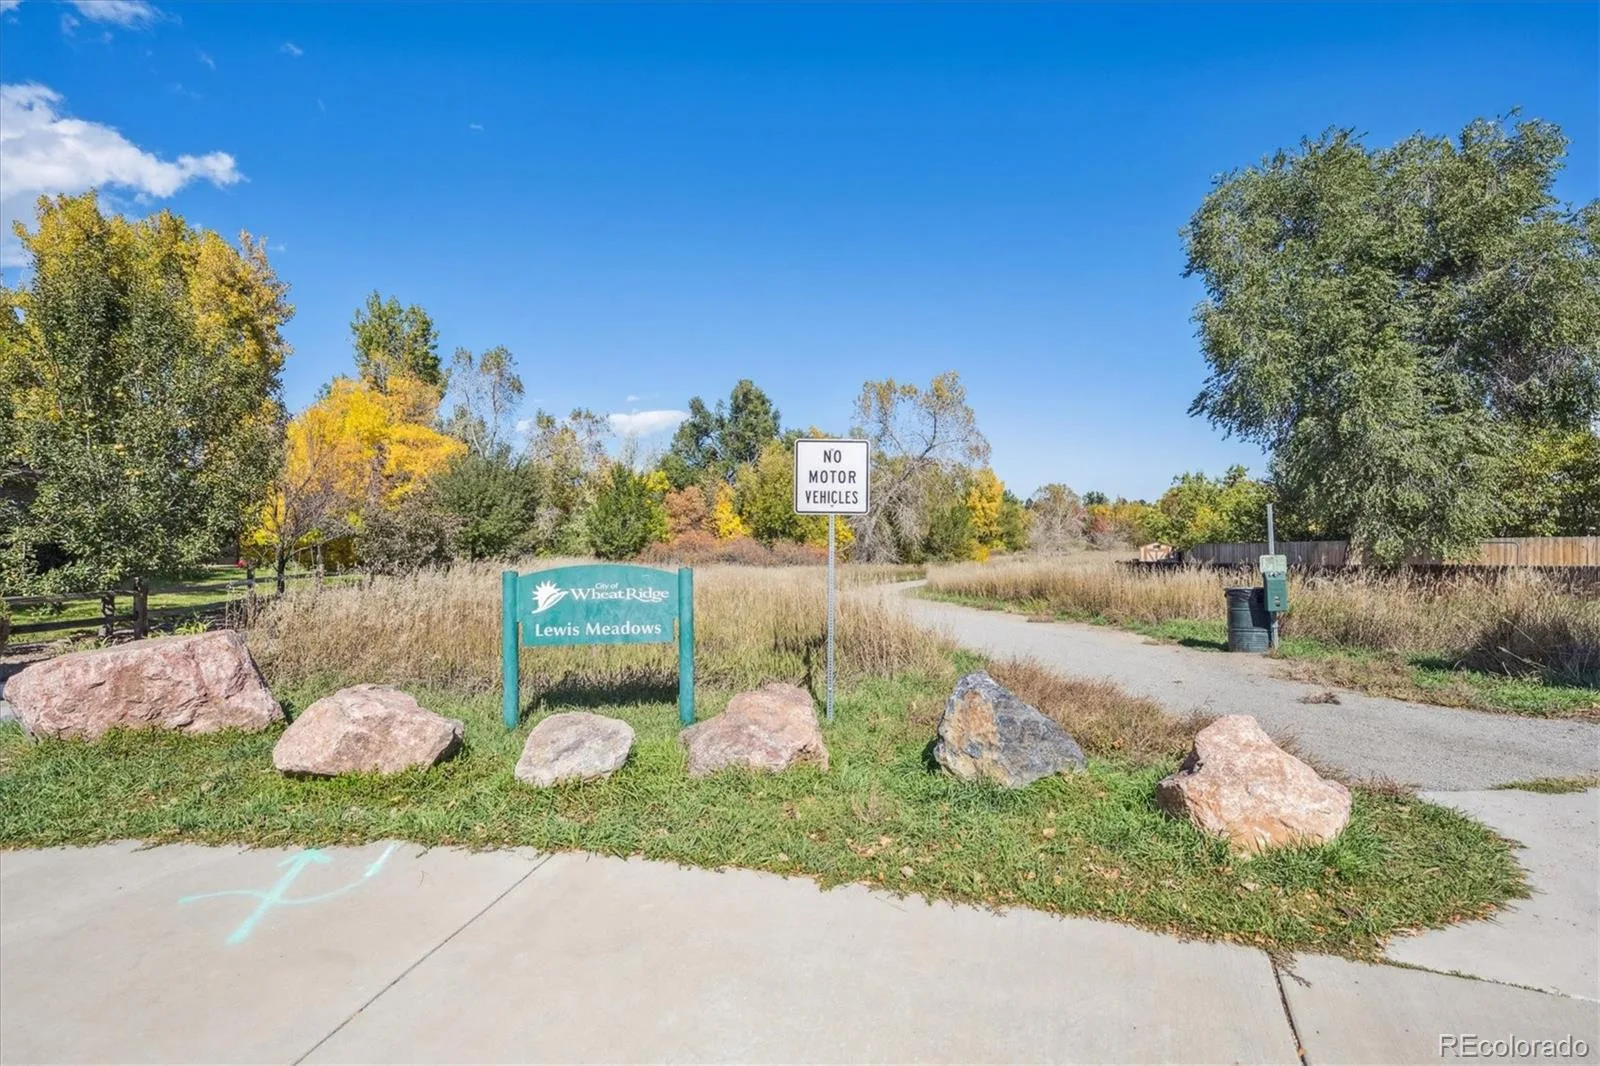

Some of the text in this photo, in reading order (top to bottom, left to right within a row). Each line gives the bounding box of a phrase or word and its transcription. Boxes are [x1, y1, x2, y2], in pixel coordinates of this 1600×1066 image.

[823, 450, 842, 463] NO
[808, 470, 856, 484] MOTOR
[805, 490, 859, 505] VEHICLES
[595, 582, 619, 590] City of
[535, 622, 662, 637] Lewis Meadows
